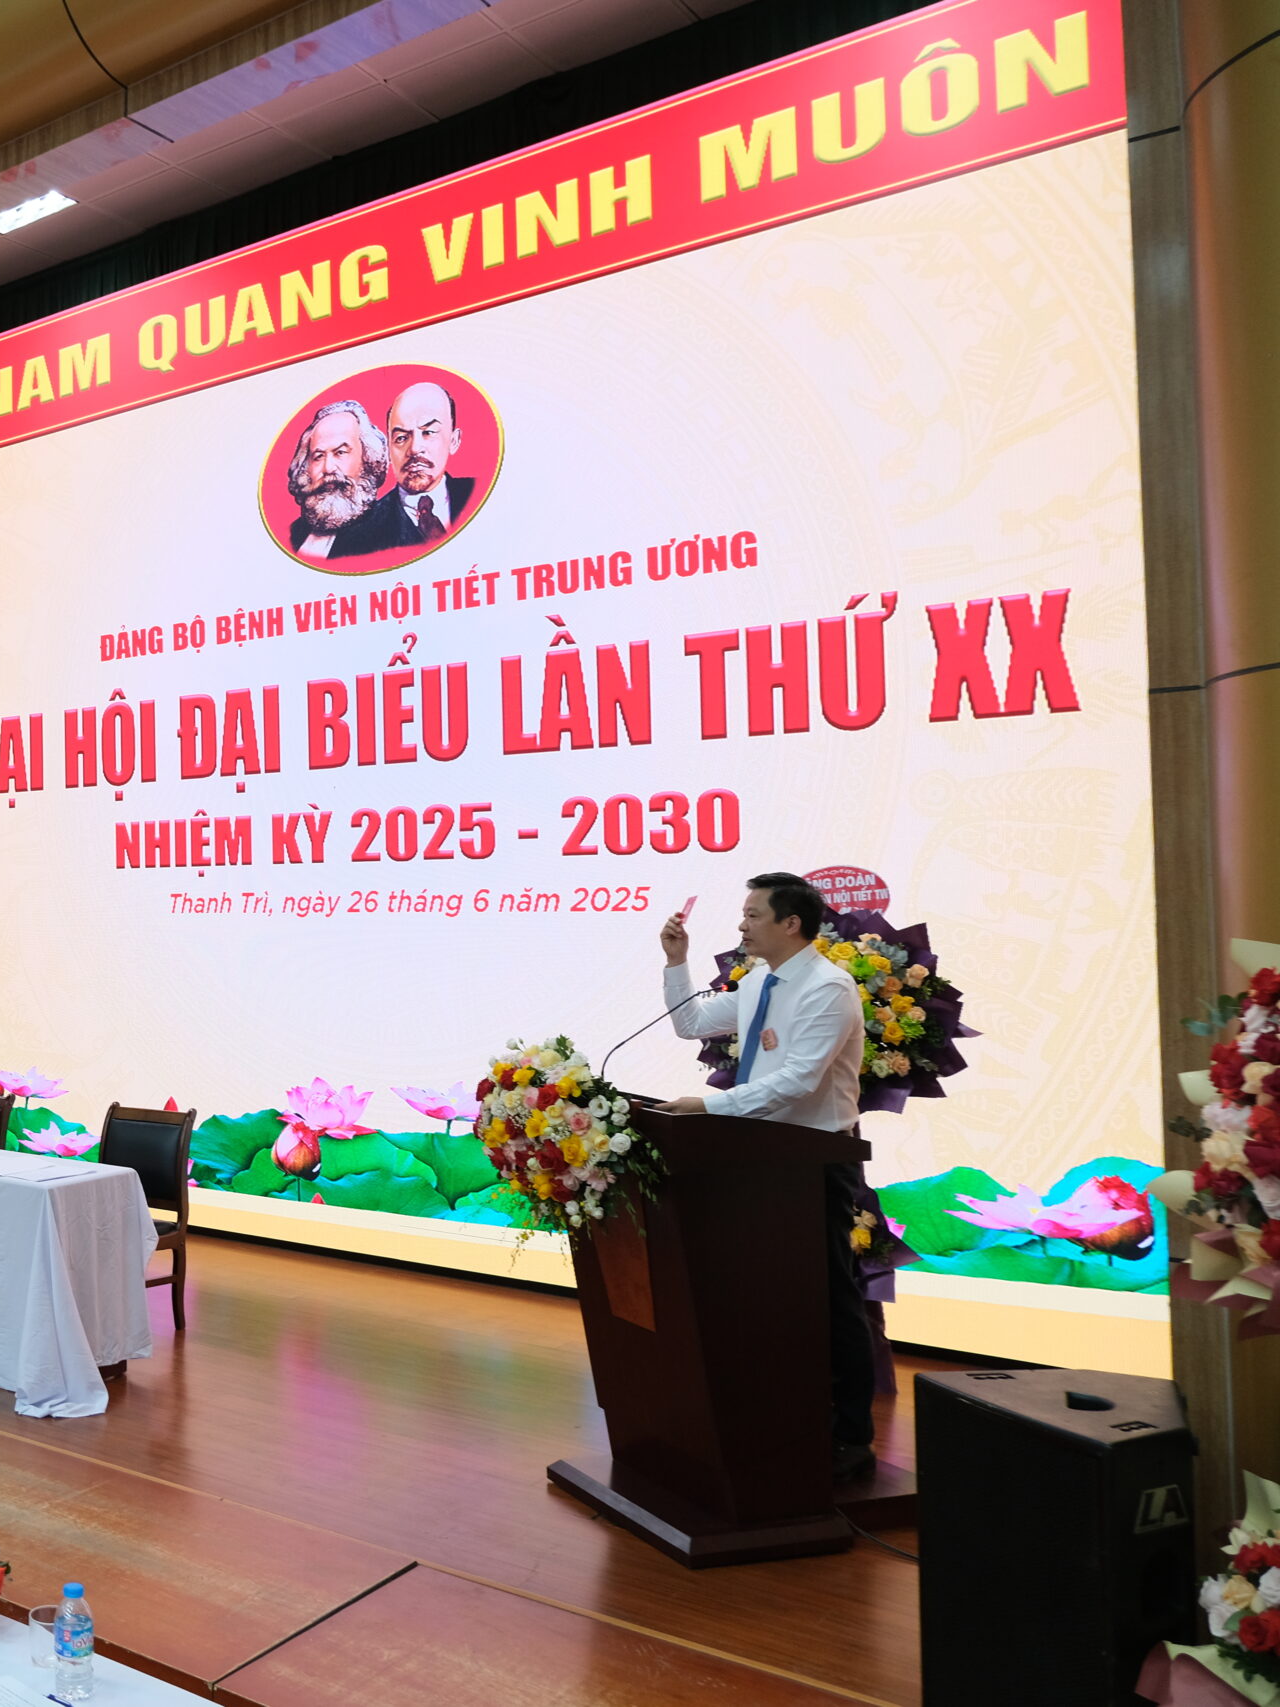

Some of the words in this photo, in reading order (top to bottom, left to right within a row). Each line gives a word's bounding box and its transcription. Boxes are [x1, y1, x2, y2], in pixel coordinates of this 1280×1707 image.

[138, 244, 389, 373] QUANG
[421, 154, 653, 283] VINH
[698, 10, 1090, 203] MUÔN
[99, 625, 164, 662] ĐẢNG
[172, 614, 206, 654] BỘ
[215, 606, 285, 647] BỆNH
[293, 592, 358, 634] VIỆN
[369, 581, 422, 623] NỘI
[431, 563, 501, 613] TIẾT
[510, 550, 633, 601] TRUNG
[646, 530, 758, 582] ƯƠNG
[64, 687, 157, 800] HỘI
[176, 684, 281, 792] ĐẠI
[306, 631, 469, 768] BIỂU
[500, 614, 653, 754] LẦN
[683, 590, 899, 740] THỨ
[924, 587, 1082, 723] XX
[115, 808, 253, 876] NHIỆM
[271, 803, 333, 863] KỲ
[350, 801, 497, 861] 2025
[517, 828, 539, 837] -
[560, 788, 741, 855] 2030
[169, 893, 233, 914] Thanh
[241, 892, 273, 915] Trì,
[282, 895, 341, 918] ngày
[346, 890, 379, 913] 26
[387, 888, 464, 918] tháng
[473, 888, 491, 913] 6
[498, 887, 561, 913] năm
[569, 886, 652, 913] 2025
[806, 878, 832, 889] NG
[835, 873, 876, 888] ĐOÀN
[852, 886, 872, 901] TIẾT
